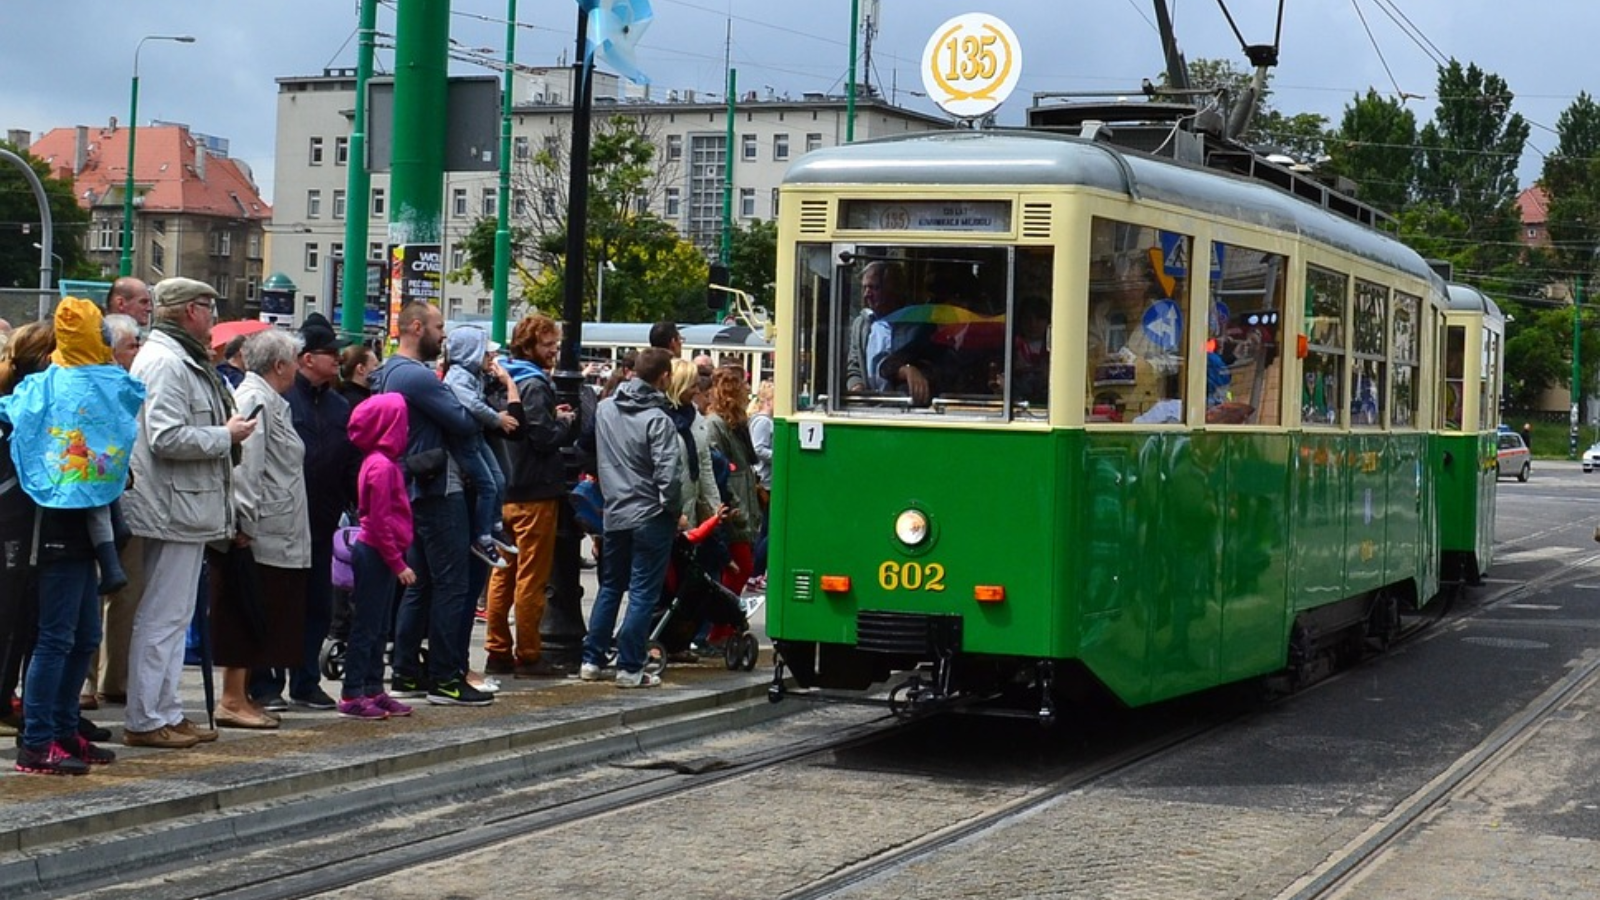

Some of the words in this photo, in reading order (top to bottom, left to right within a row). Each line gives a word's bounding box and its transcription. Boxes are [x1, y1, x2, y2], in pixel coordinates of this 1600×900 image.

[946, 35, 997, 81] 135
[807, 426, 815, 443] 1
[879, 560, 946, 592] 602
